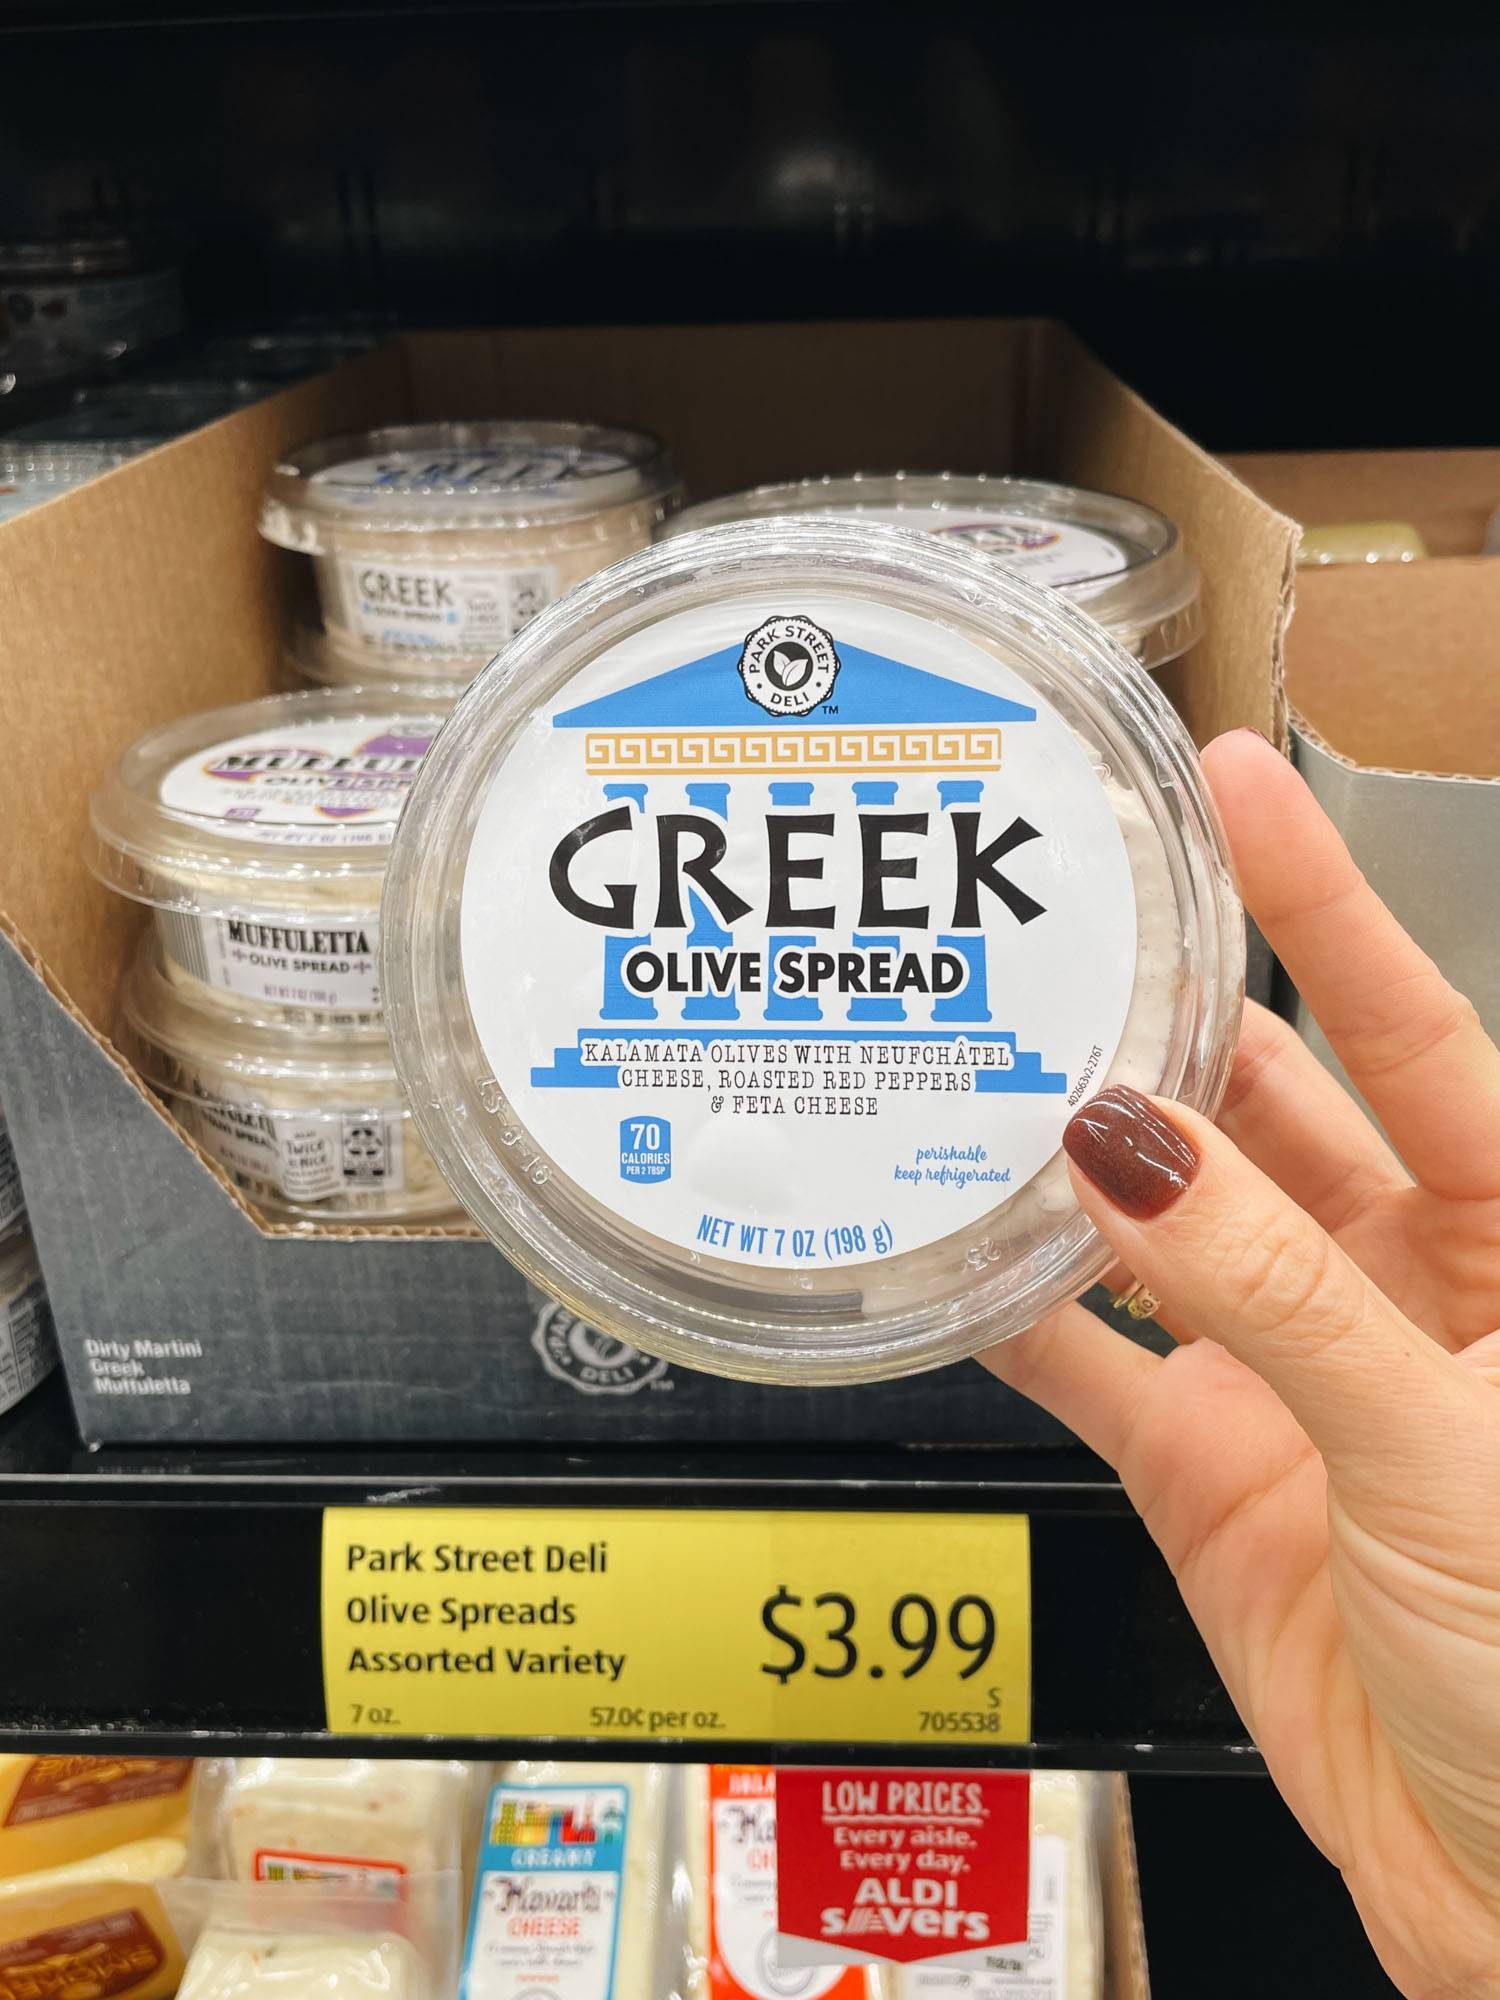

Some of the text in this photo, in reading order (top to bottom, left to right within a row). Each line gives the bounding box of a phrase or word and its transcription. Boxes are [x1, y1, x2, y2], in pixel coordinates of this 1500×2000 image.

[359, 569, 454, 608] GREEK
[749, 625, 829, 674] PARK STREET
[770, 692, 810, 707] DELI
[549, 805, 1047, 930] GREEK
[227, 919, 370, 955] MUFFULETTA
[249, 953, 351, 974] OLIVE SPREAD
[626, 951, 964, 994] OLIVE SPREAD
[584, 1040, 1010, 1066] KALAMATA OLIVES WITH NEUFCHÂTEL
[622, 1069, 971, 1092] CHEESE, ROASTED RED PEPPERS
[711, 1096, 878, 1115] & FETA CHEESE
[630, 1123, 660, 1150] 70
[621, 1152, 670, 1165] CALORIES
[916, 1144, 988, 1165] perishable
[626, 1166, 666, 1175] PER 2 TBSP
[894, 1165, 1011, 1190] keep refrigerated
[697, 1214, 893, 1260] NET WT 7 OZ (198 g)
[84, 1338, 203, 1361] Dirty Martini
[89, 1358, 146, 1377] Greek
[579, 1366, 635, 1383] DELI
[95, 1376, 191, 1395] Muffuletta
[347, 1542, 608, 1574] Park Street Deli
[347, 1594, 577, 1633] Olive Spreads
[760, 1584, 997, 1686] $3.99
[348, 1646, 626, 1682] Assorted Variety
[987, 1687, 1002, 1709] S
[350, 1704, 365, 1726] 7
[589, 1706, 726, 1733] 57.0¢ per oz.
[918, 1710, 1001, 1733] 705538
[821, 1779, 991, 1817] LOW PRICES.
[833, 1824, 978, 1854] Every aisle.
[840, 1850, 971, 1875] Every day.
[853, 1877, 959, 1908] ALDI
[507, 1915, 582, 1937] CHEESE
